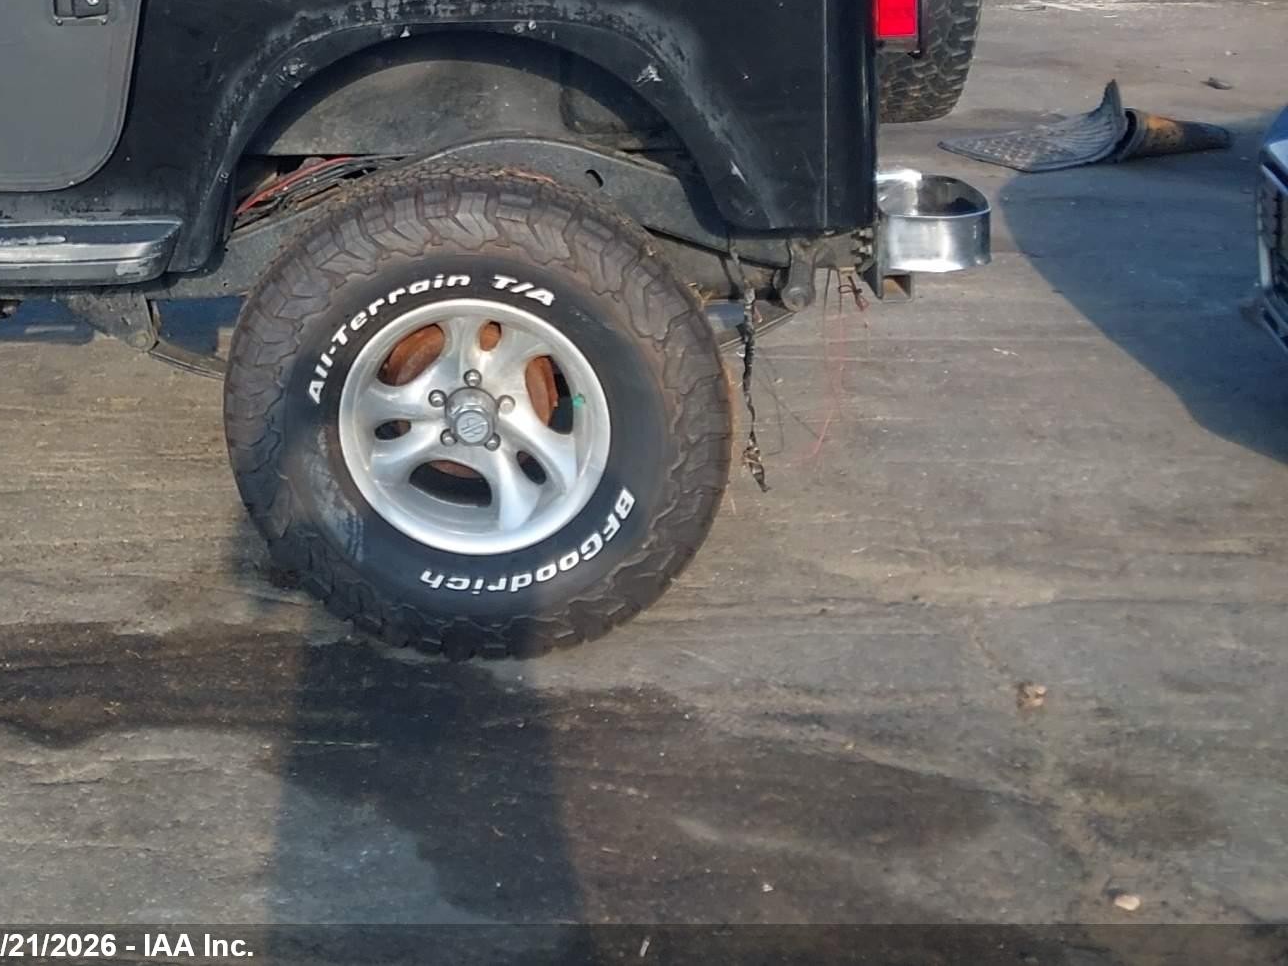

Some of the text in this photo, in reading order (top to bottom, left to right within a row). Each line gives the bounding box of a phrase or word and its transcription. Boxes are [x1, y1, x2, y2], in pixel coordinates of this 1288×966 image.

[308, 274, 555, 405] All-Terrain T/A
[420, 487, 635, 594] BFGoodrich
